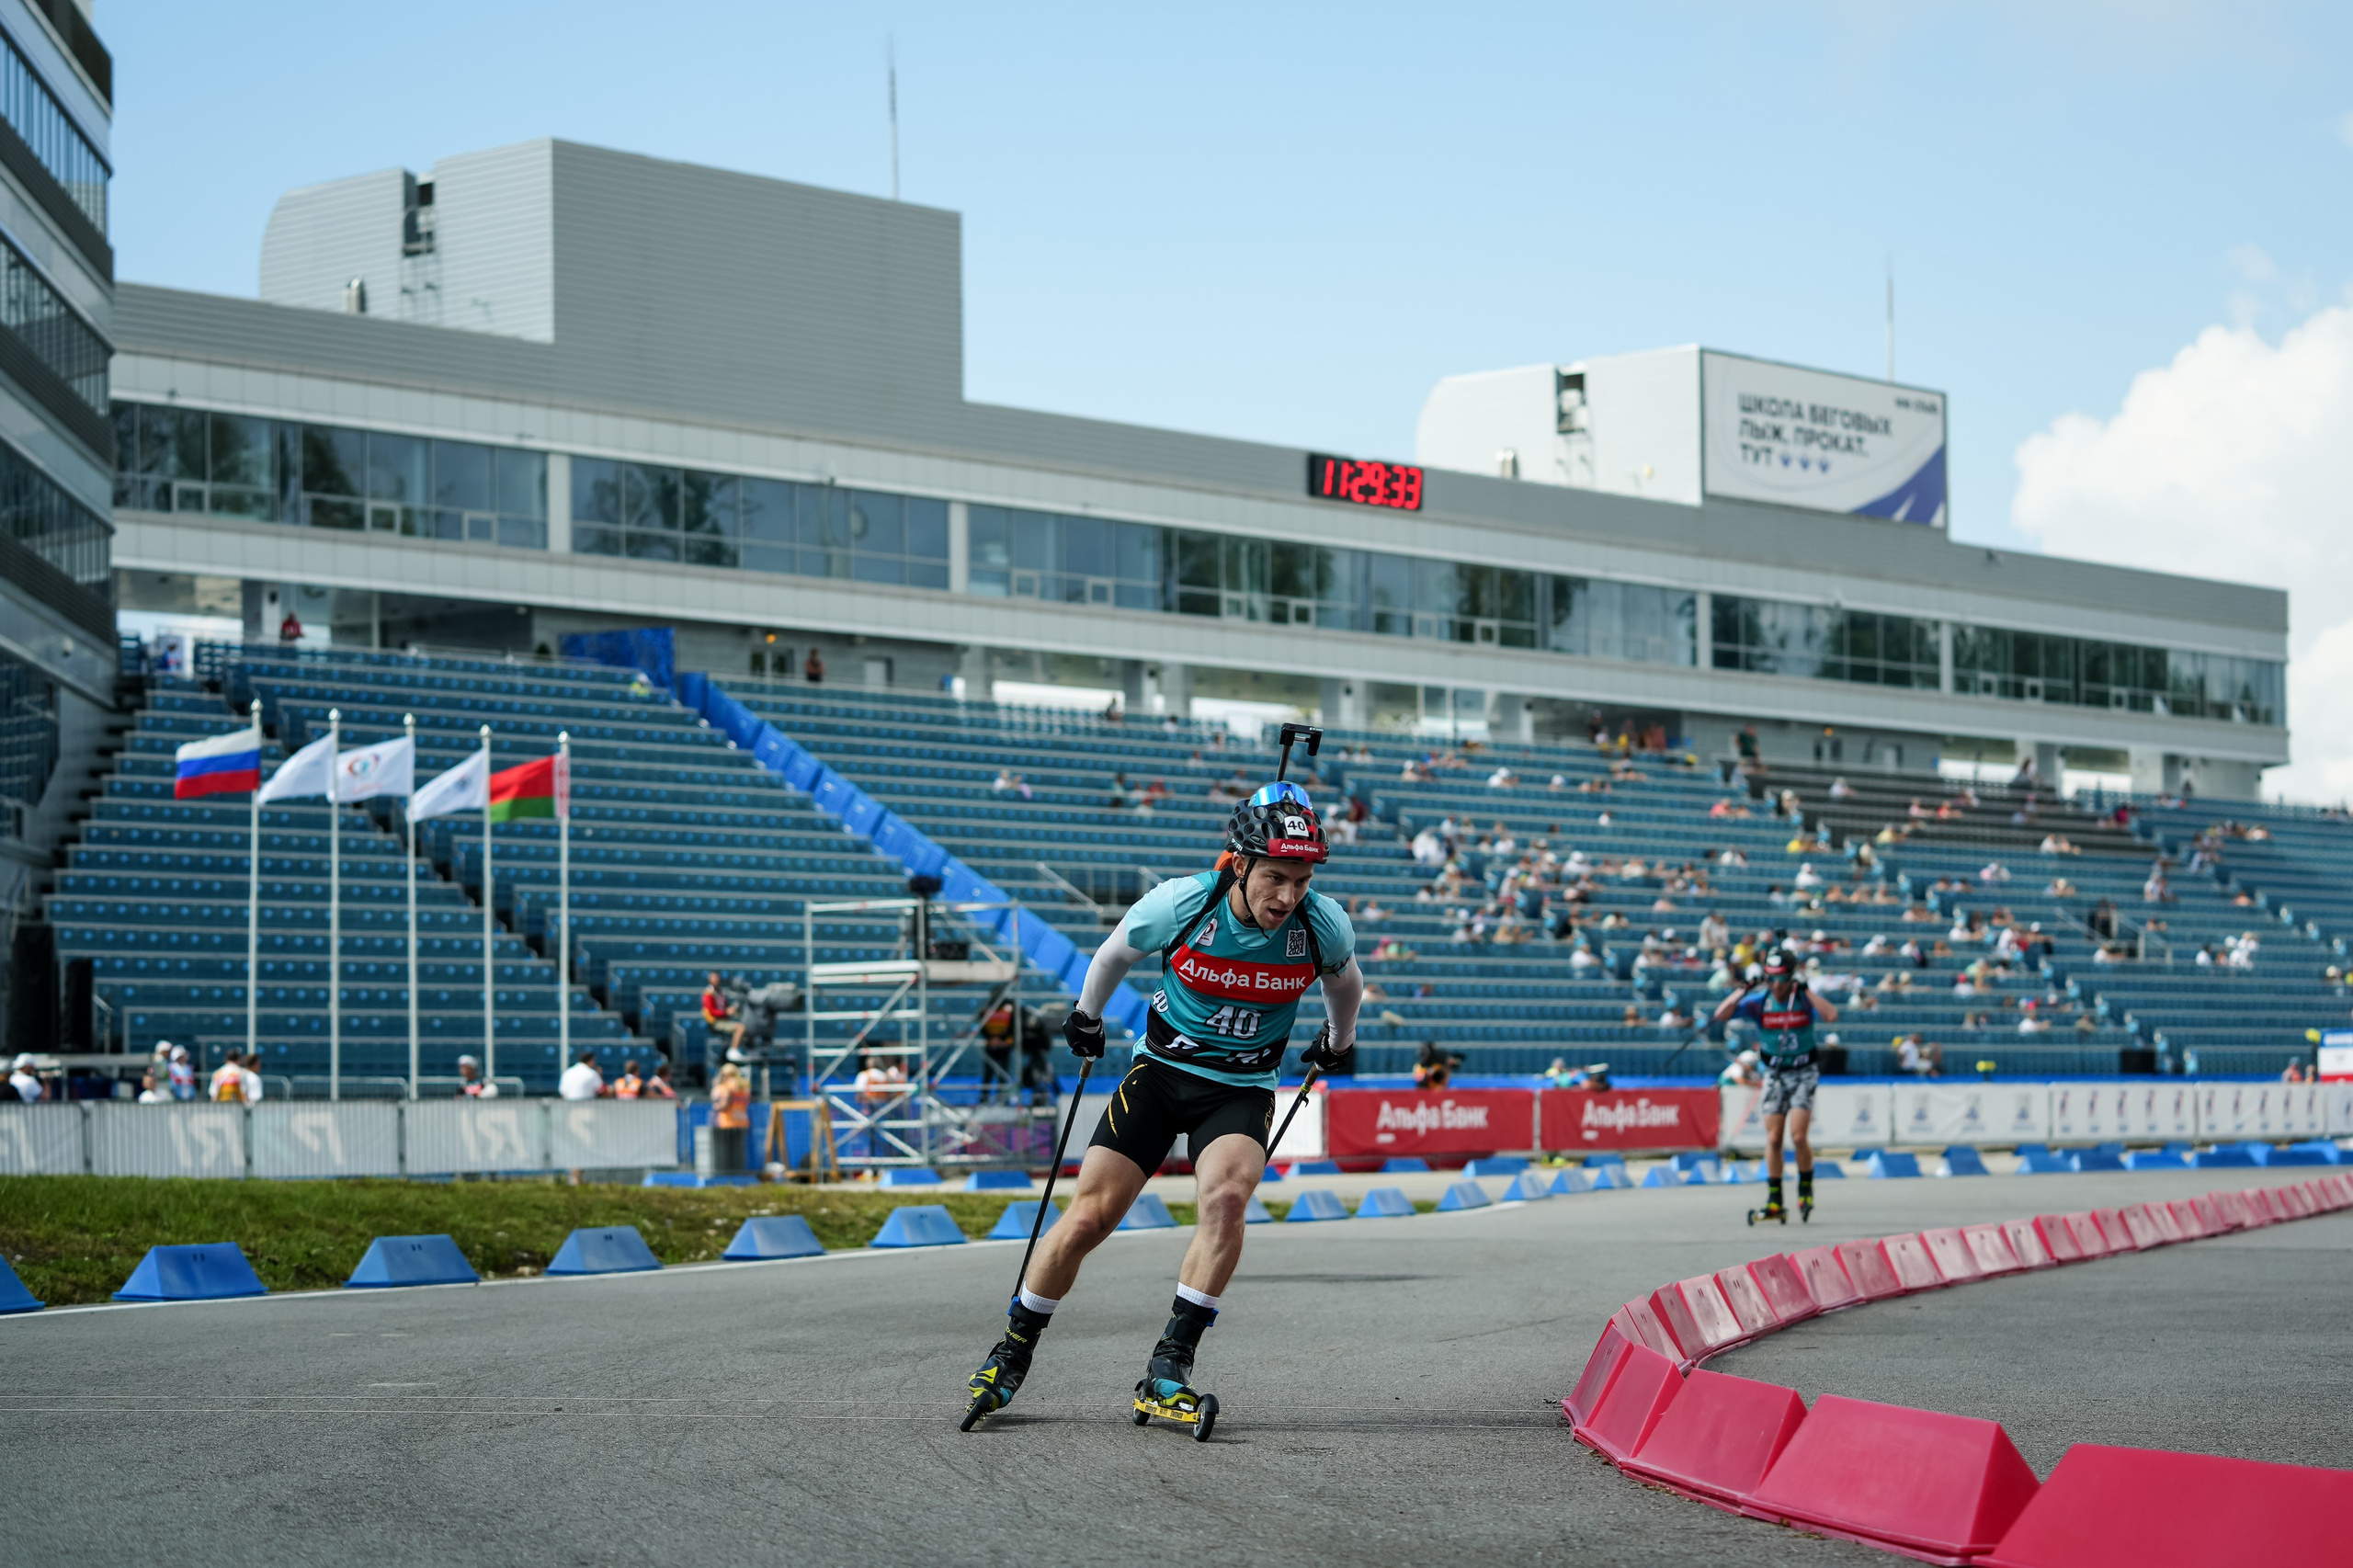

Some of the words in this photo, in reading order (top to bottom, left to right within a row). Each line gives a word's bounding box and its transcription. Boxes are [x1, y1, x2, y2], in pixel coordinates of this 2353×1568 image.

[1737, 392, 1804, 419] ШКОЛА
[1809, 404, 1893, 437] БЕГОВЫХ
[1740, 444, 1773, 466] ТУТ
[1324, 459, 1422, 510] 11:29:33
[1288, 820, 1306, 832] 40
[1280, 843, 1304, 852] Альфа
[1304, 844, 1319, 853] Банк
[1289, 945, 1303, 955] 2024
[1179, 959, 1250, 988] Альфа
[1256, 971, 1306, 990] Банк
[1153, 989, 1169, 1013] 40
[1205, 1006, 1261, 1040] 40
[1376, 1100, 1440, 1136] Альфа
[1440, 1100, 1489, 1130] Банк
[1582, 1098, 1637, 1134] Альфа
[1638, 1097, 1679, 1127] Банк
